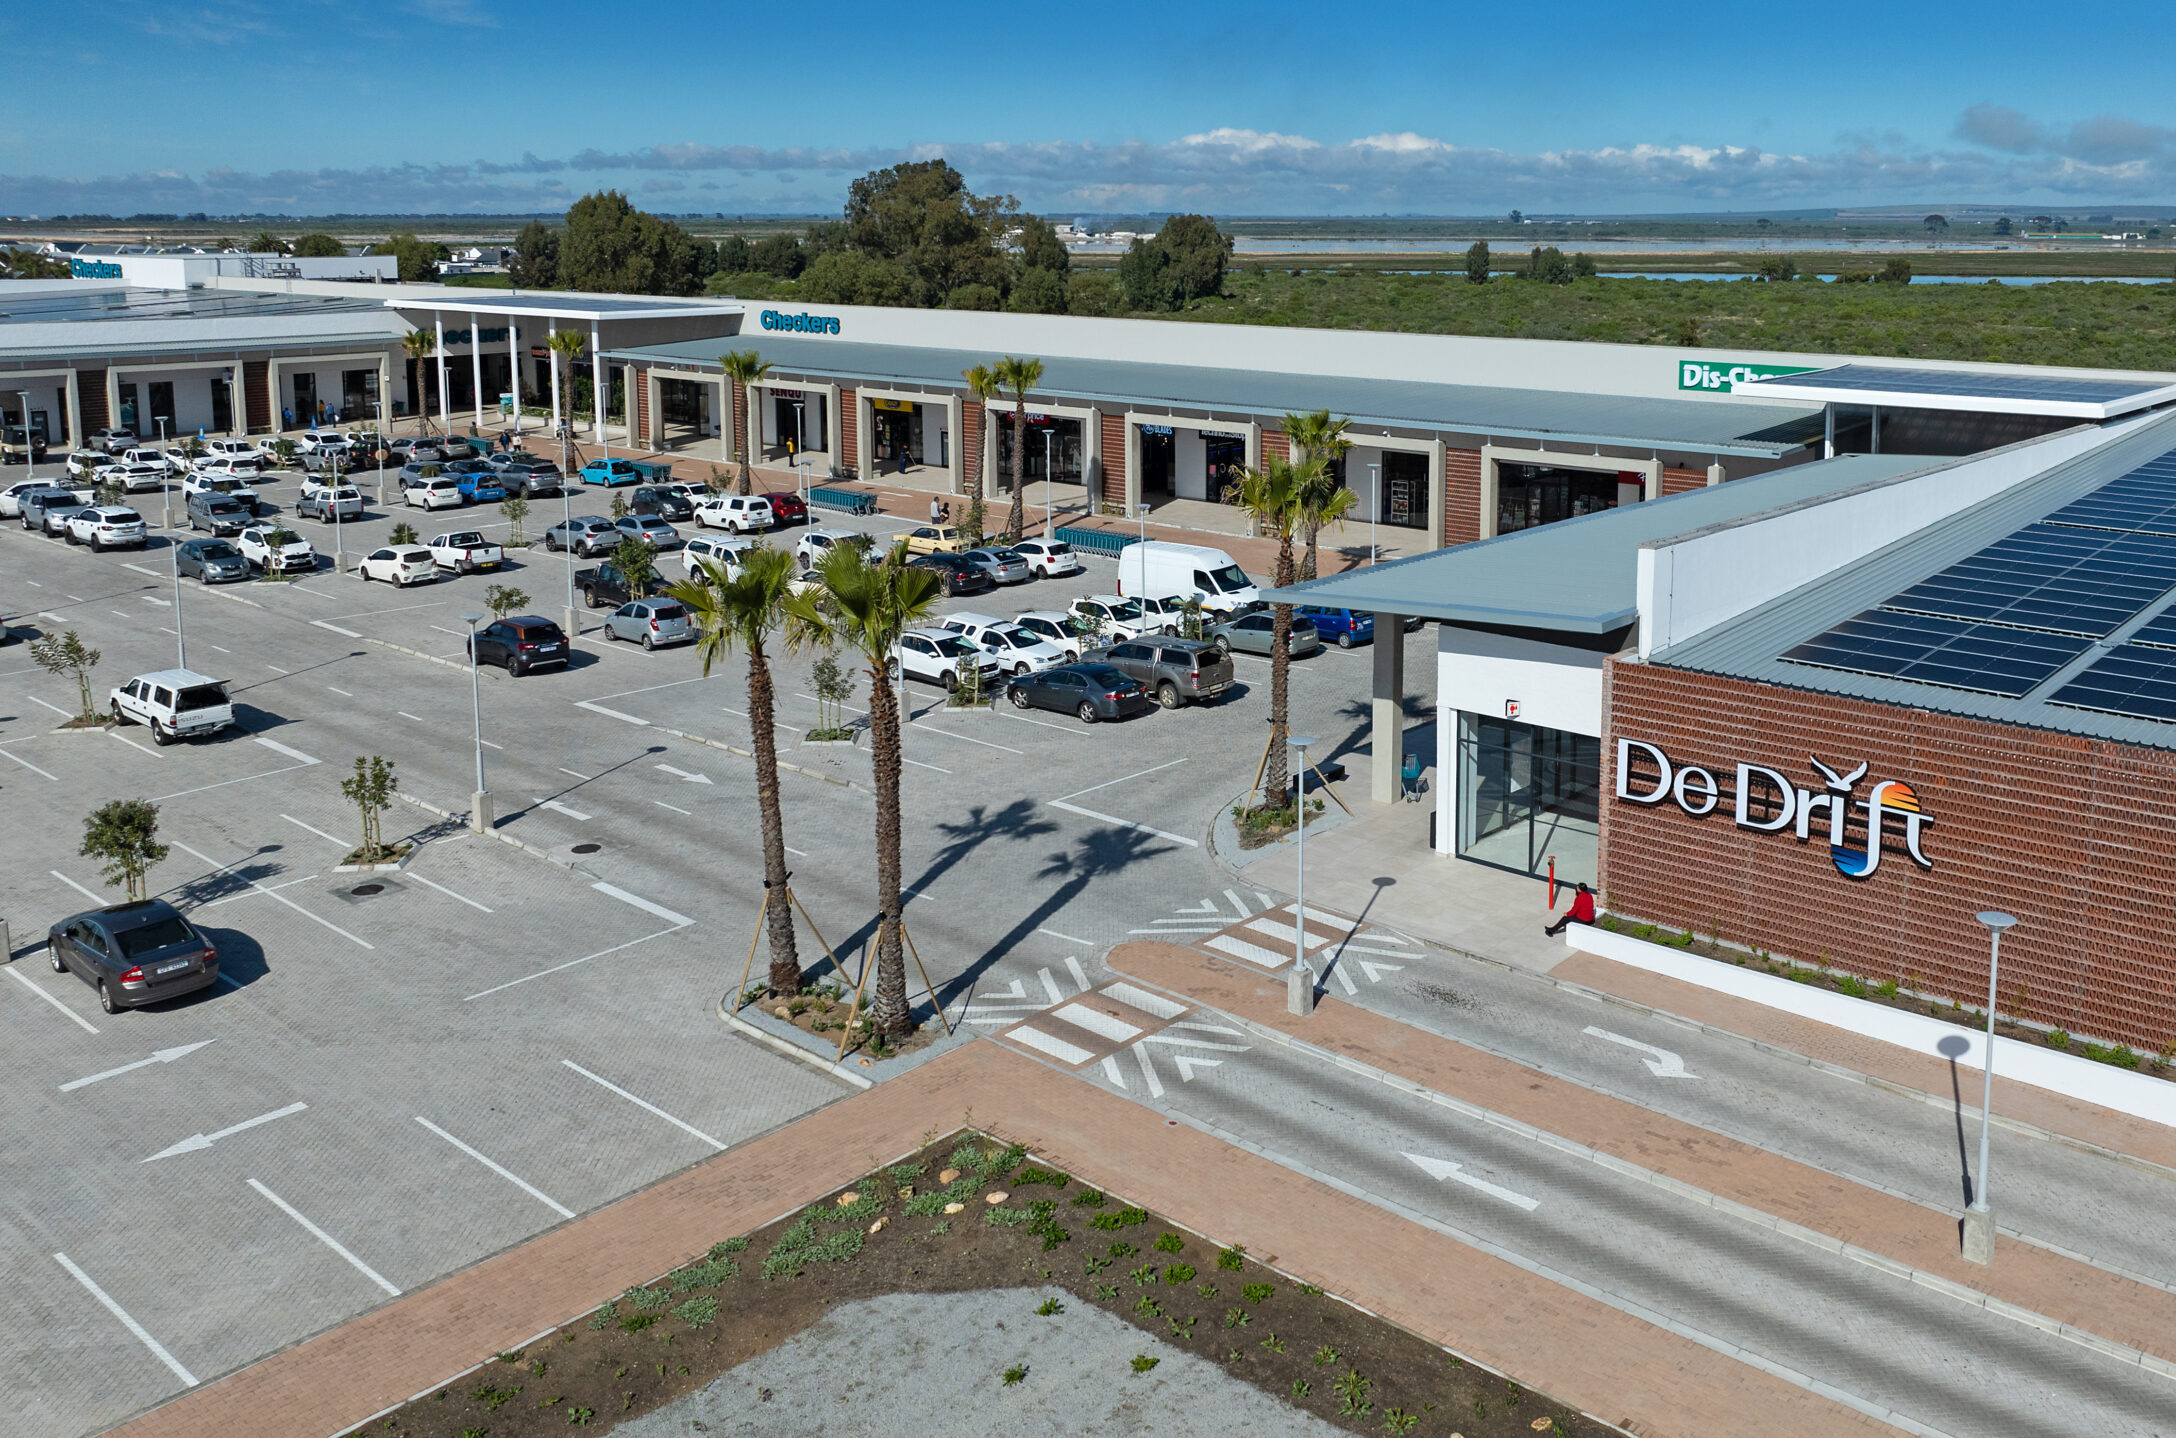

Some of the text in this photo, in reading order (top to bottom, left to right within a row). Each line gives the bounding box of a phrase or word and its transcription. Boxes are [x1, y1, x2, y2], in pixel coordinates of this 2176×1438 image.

[72, 258, 122, 278] Checkers
[761, 310, 840, 335] Checkers
[1616, 738, 1934, 877] De Drift
